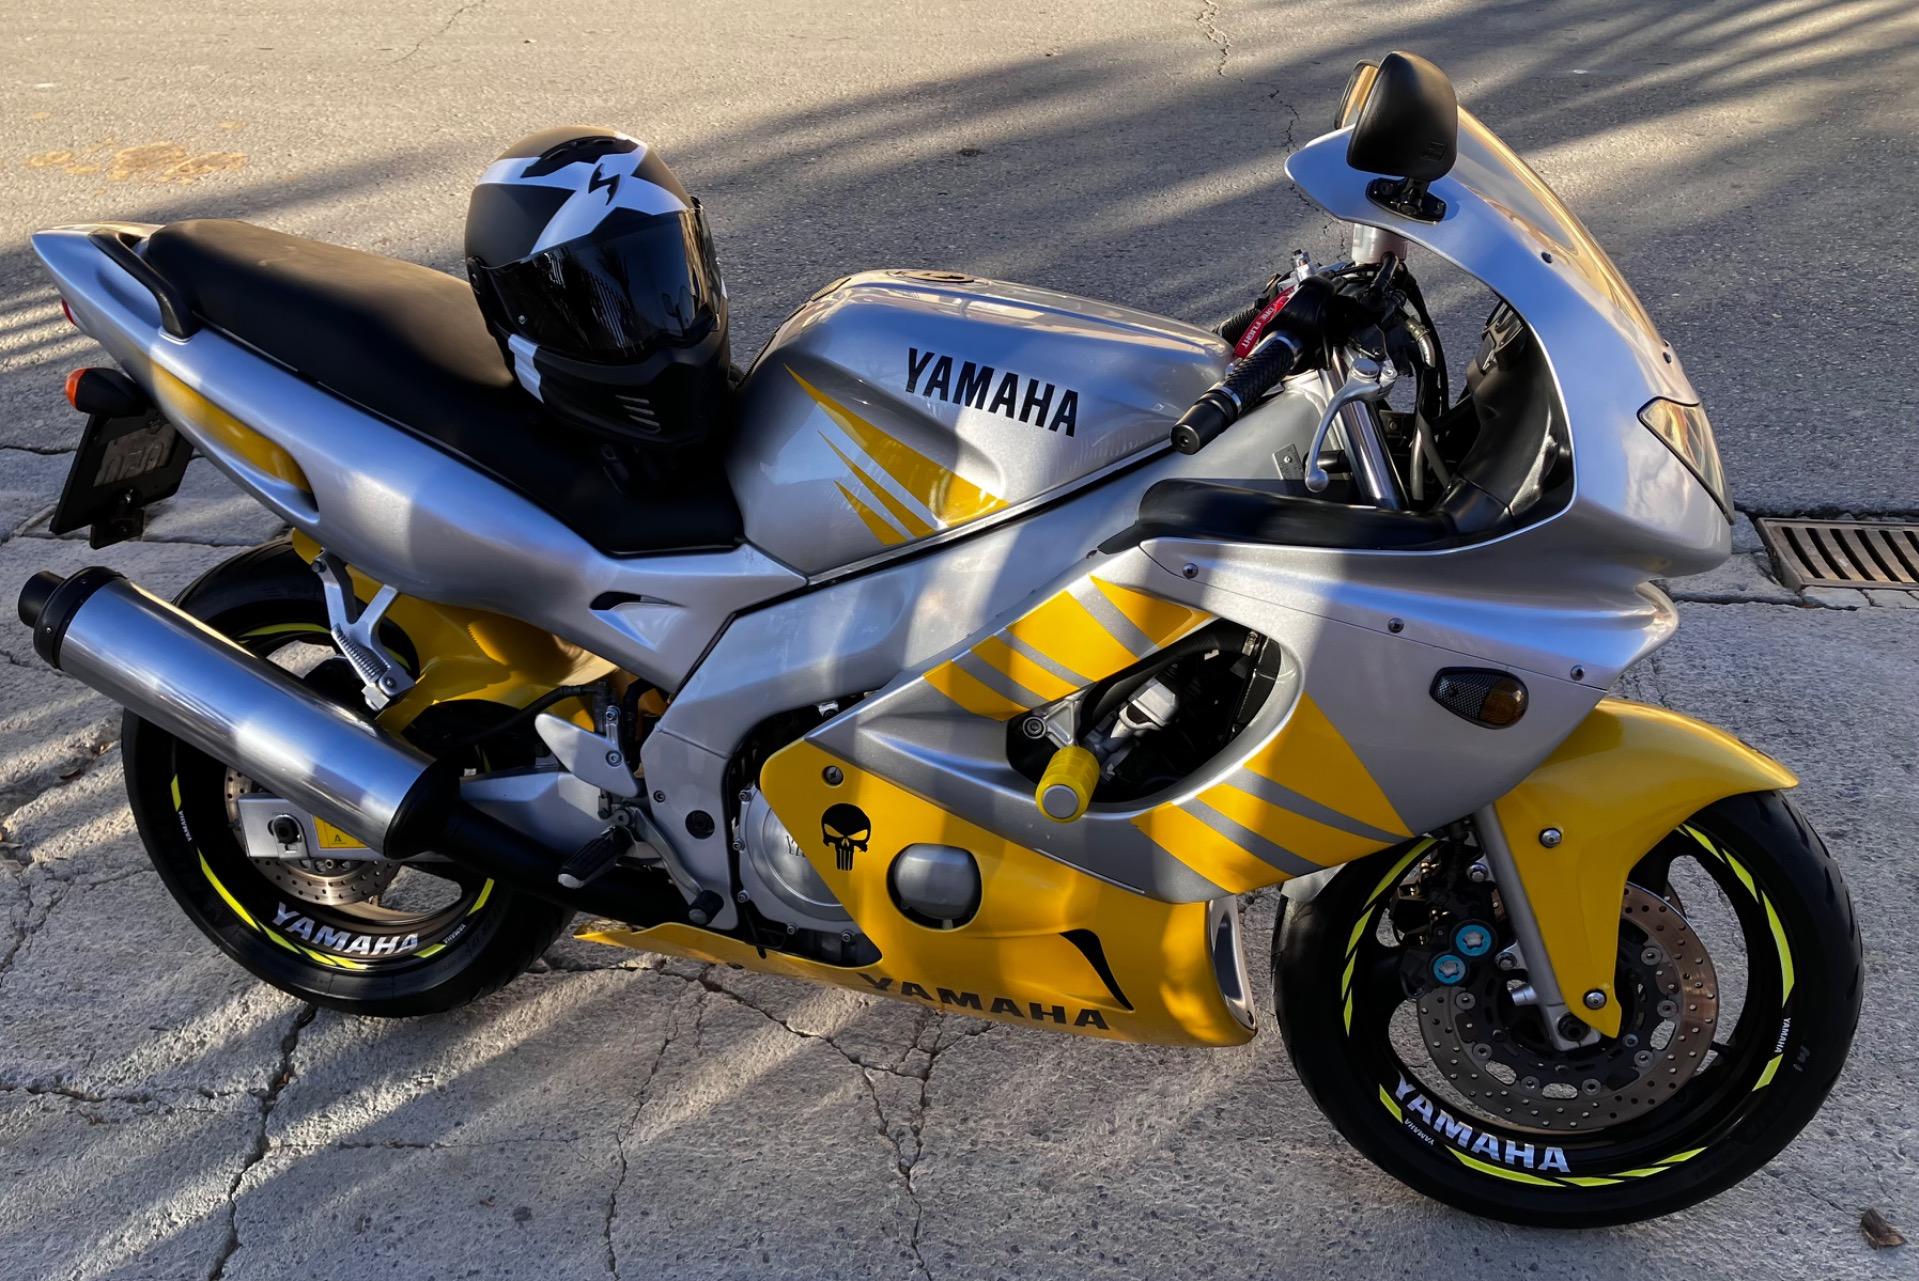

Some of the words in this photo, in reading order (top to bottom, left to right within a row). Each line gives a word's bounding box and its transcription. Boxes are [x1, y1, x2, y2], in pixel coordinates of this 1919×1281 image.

[905, 347, 1079, 437] YAMAHA
[271, 902, 420, 956] YAMAHA
[856, 972, 1110, 1030] YAMAHA
[1774, 1017, 1791, 1053] YAMAHA
[1395, 1074, 1571, 1173] YAMAHA
[1404, 1117, 1435, 1147] YAMAHA
